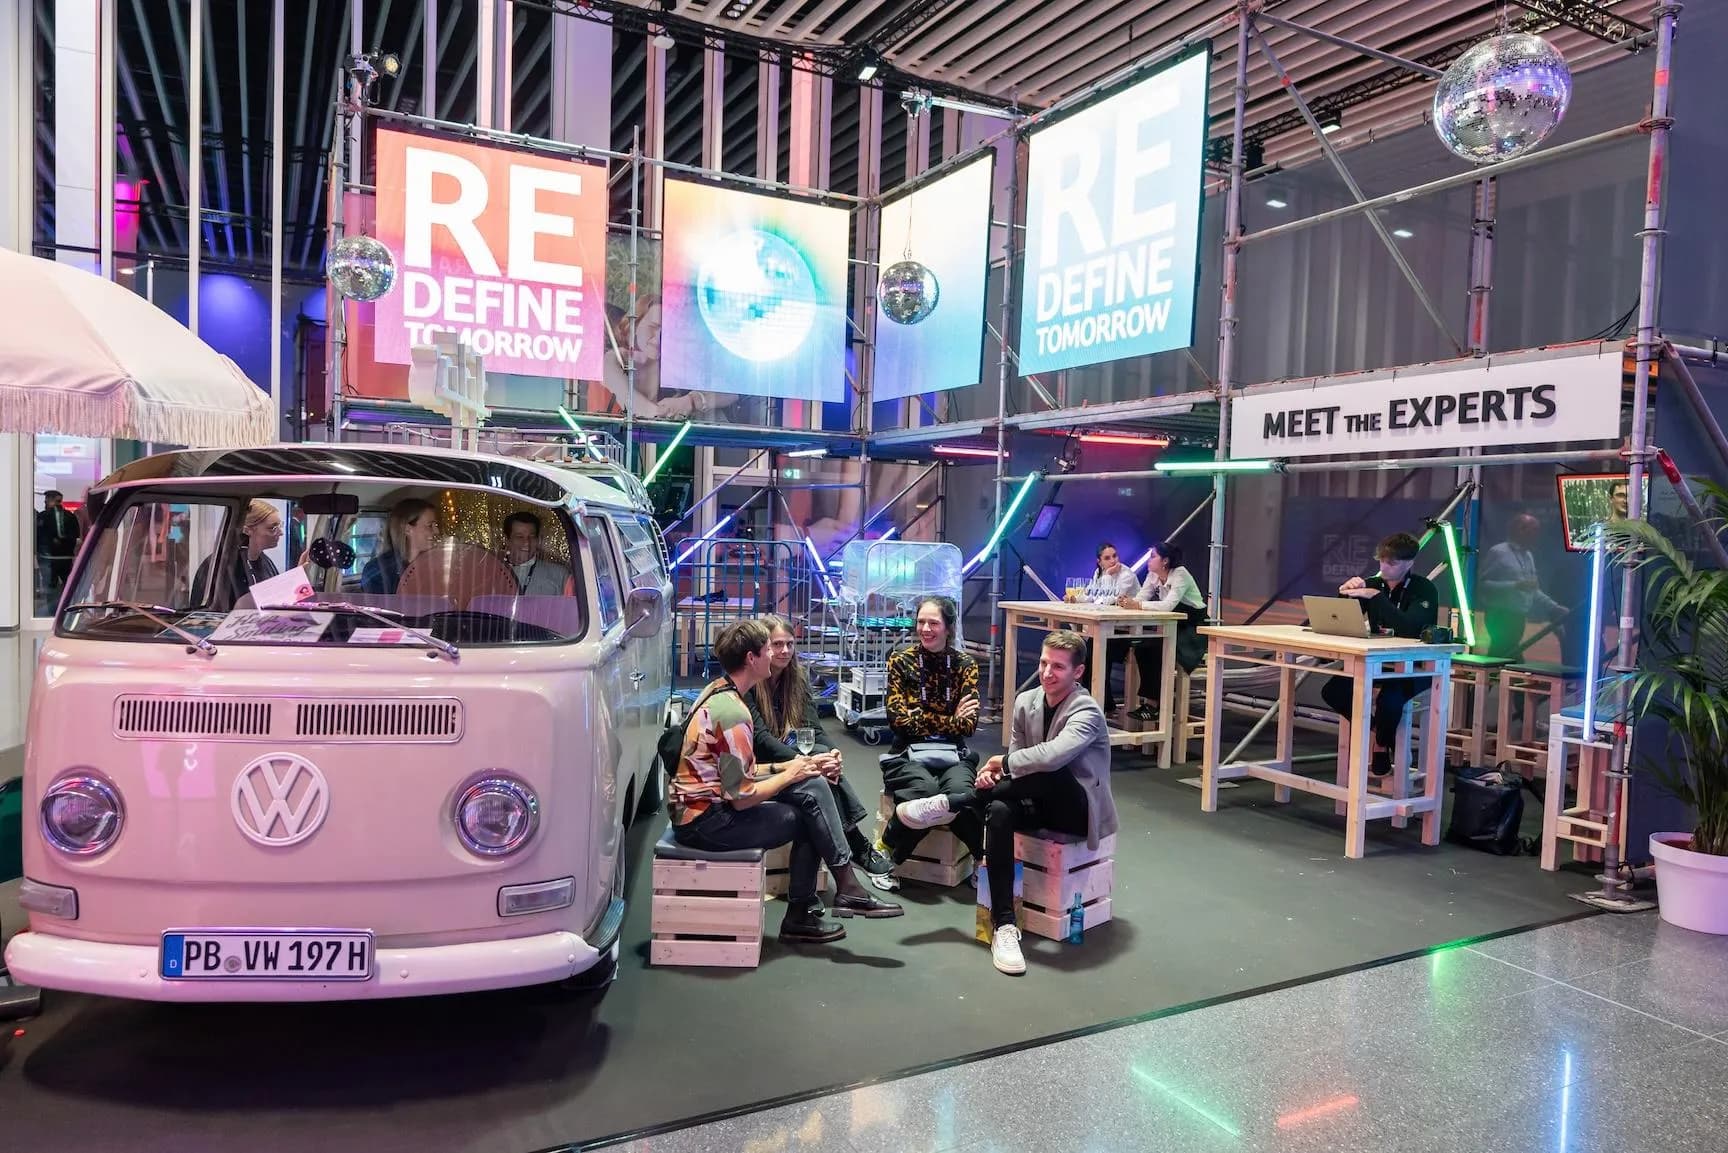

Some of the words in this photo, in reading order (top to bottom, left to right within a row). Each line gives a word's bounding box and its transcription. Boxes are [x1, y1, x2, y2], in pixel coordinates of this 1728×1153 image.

[1039, 79, 1181, 269] RE
[404, 146, 583, 287] RE
[404, 271, 584, 334] DEFINE
[1036, 237, 1174, 323] DEFINE
[1036, 298, 1172, 356] TOMORROW
[1263, 406, 1341, 439] MEET
[1344, 412, 1382, 433] THE
[1388, 384, 1556, 430] EXPERTS
[184, 941, 222, 971] PB
[244, 941, 281, 971] VW
[288, 941, 342, 971] 197
[348, 941, 366, 971] H
